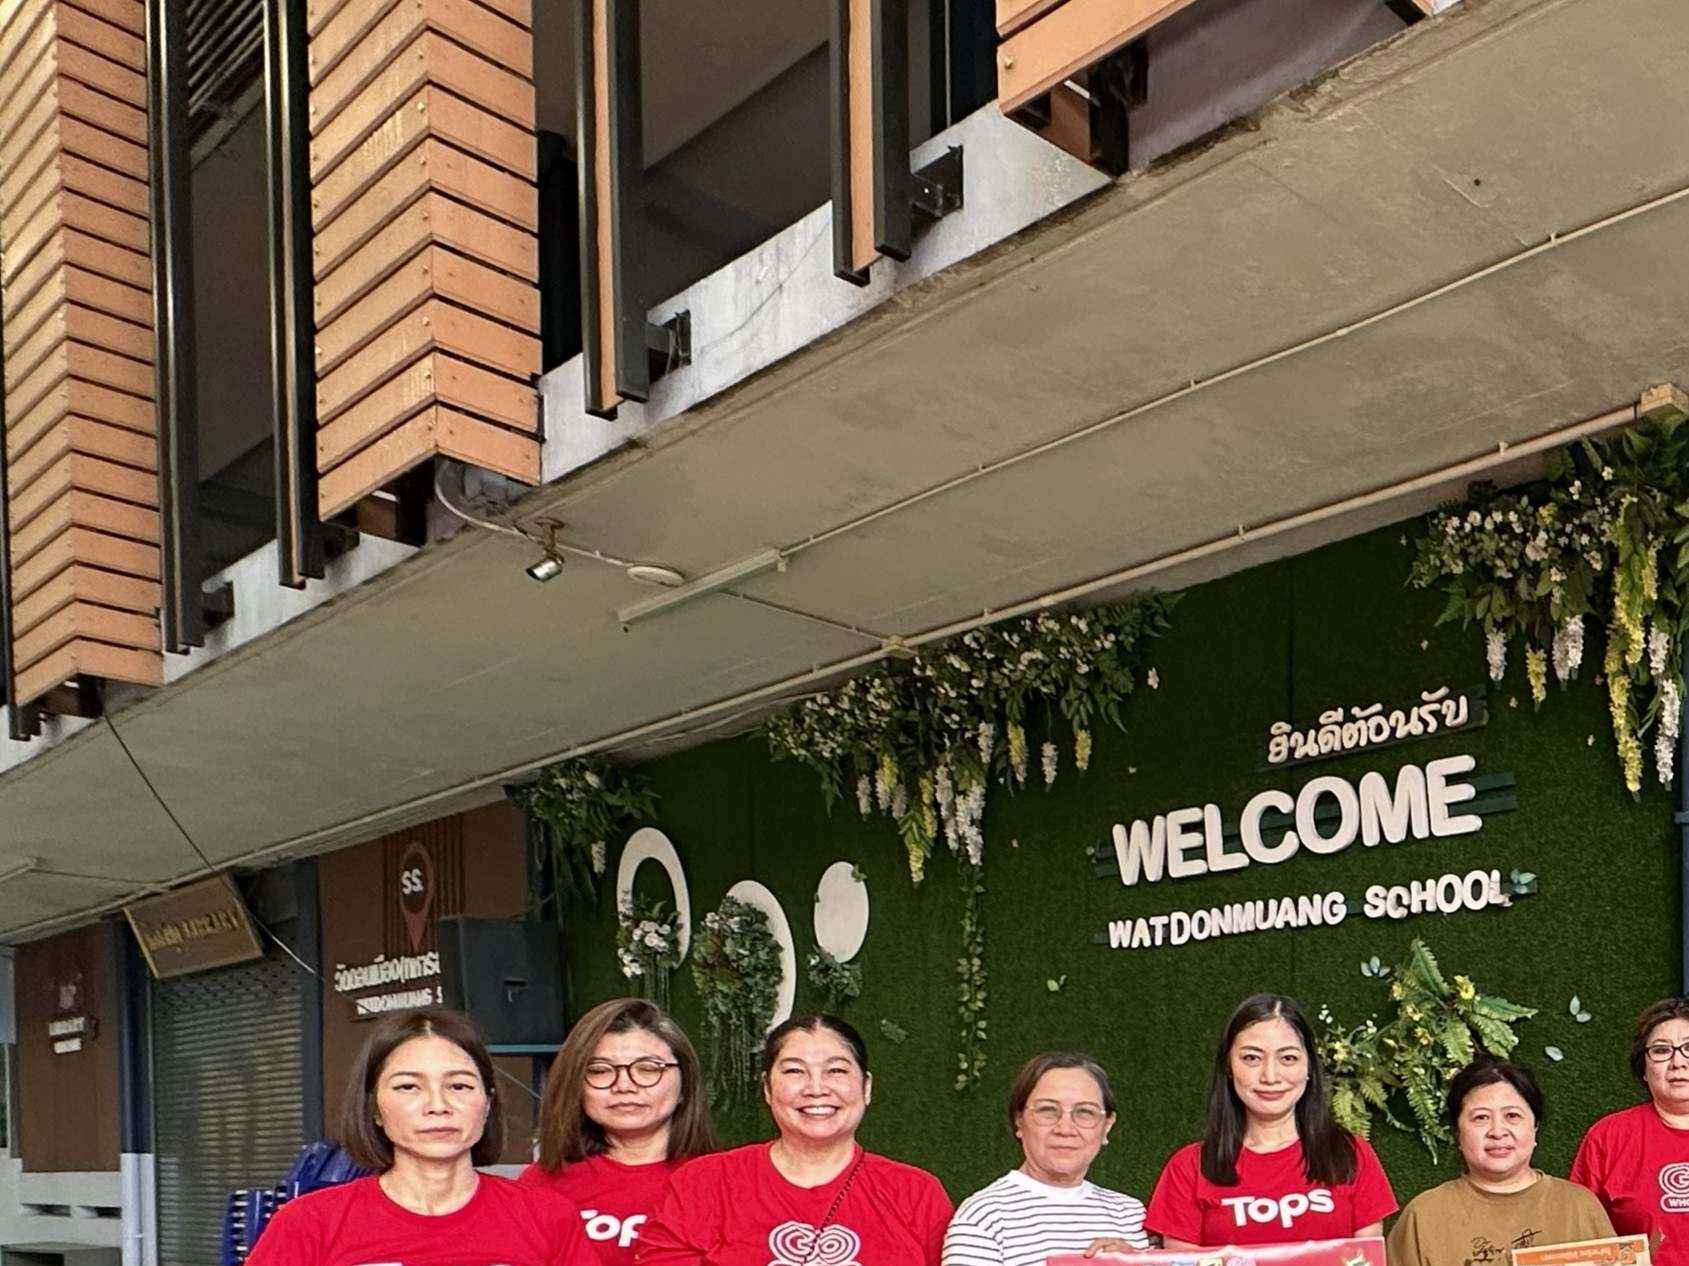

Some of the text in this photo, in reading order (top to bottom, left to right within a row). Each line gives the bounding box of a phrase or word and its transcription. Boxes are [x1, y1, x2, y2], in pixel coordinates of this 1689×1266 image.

[1267, 686, 1468, 764] ยินดีต้อนรับ
[1112, 754, 1482, 887] WELCOME
[1108, 870, 1507, 949] WATDONMUANG SCHOOL
[1221, 1188, 1335, 1229] Tops
